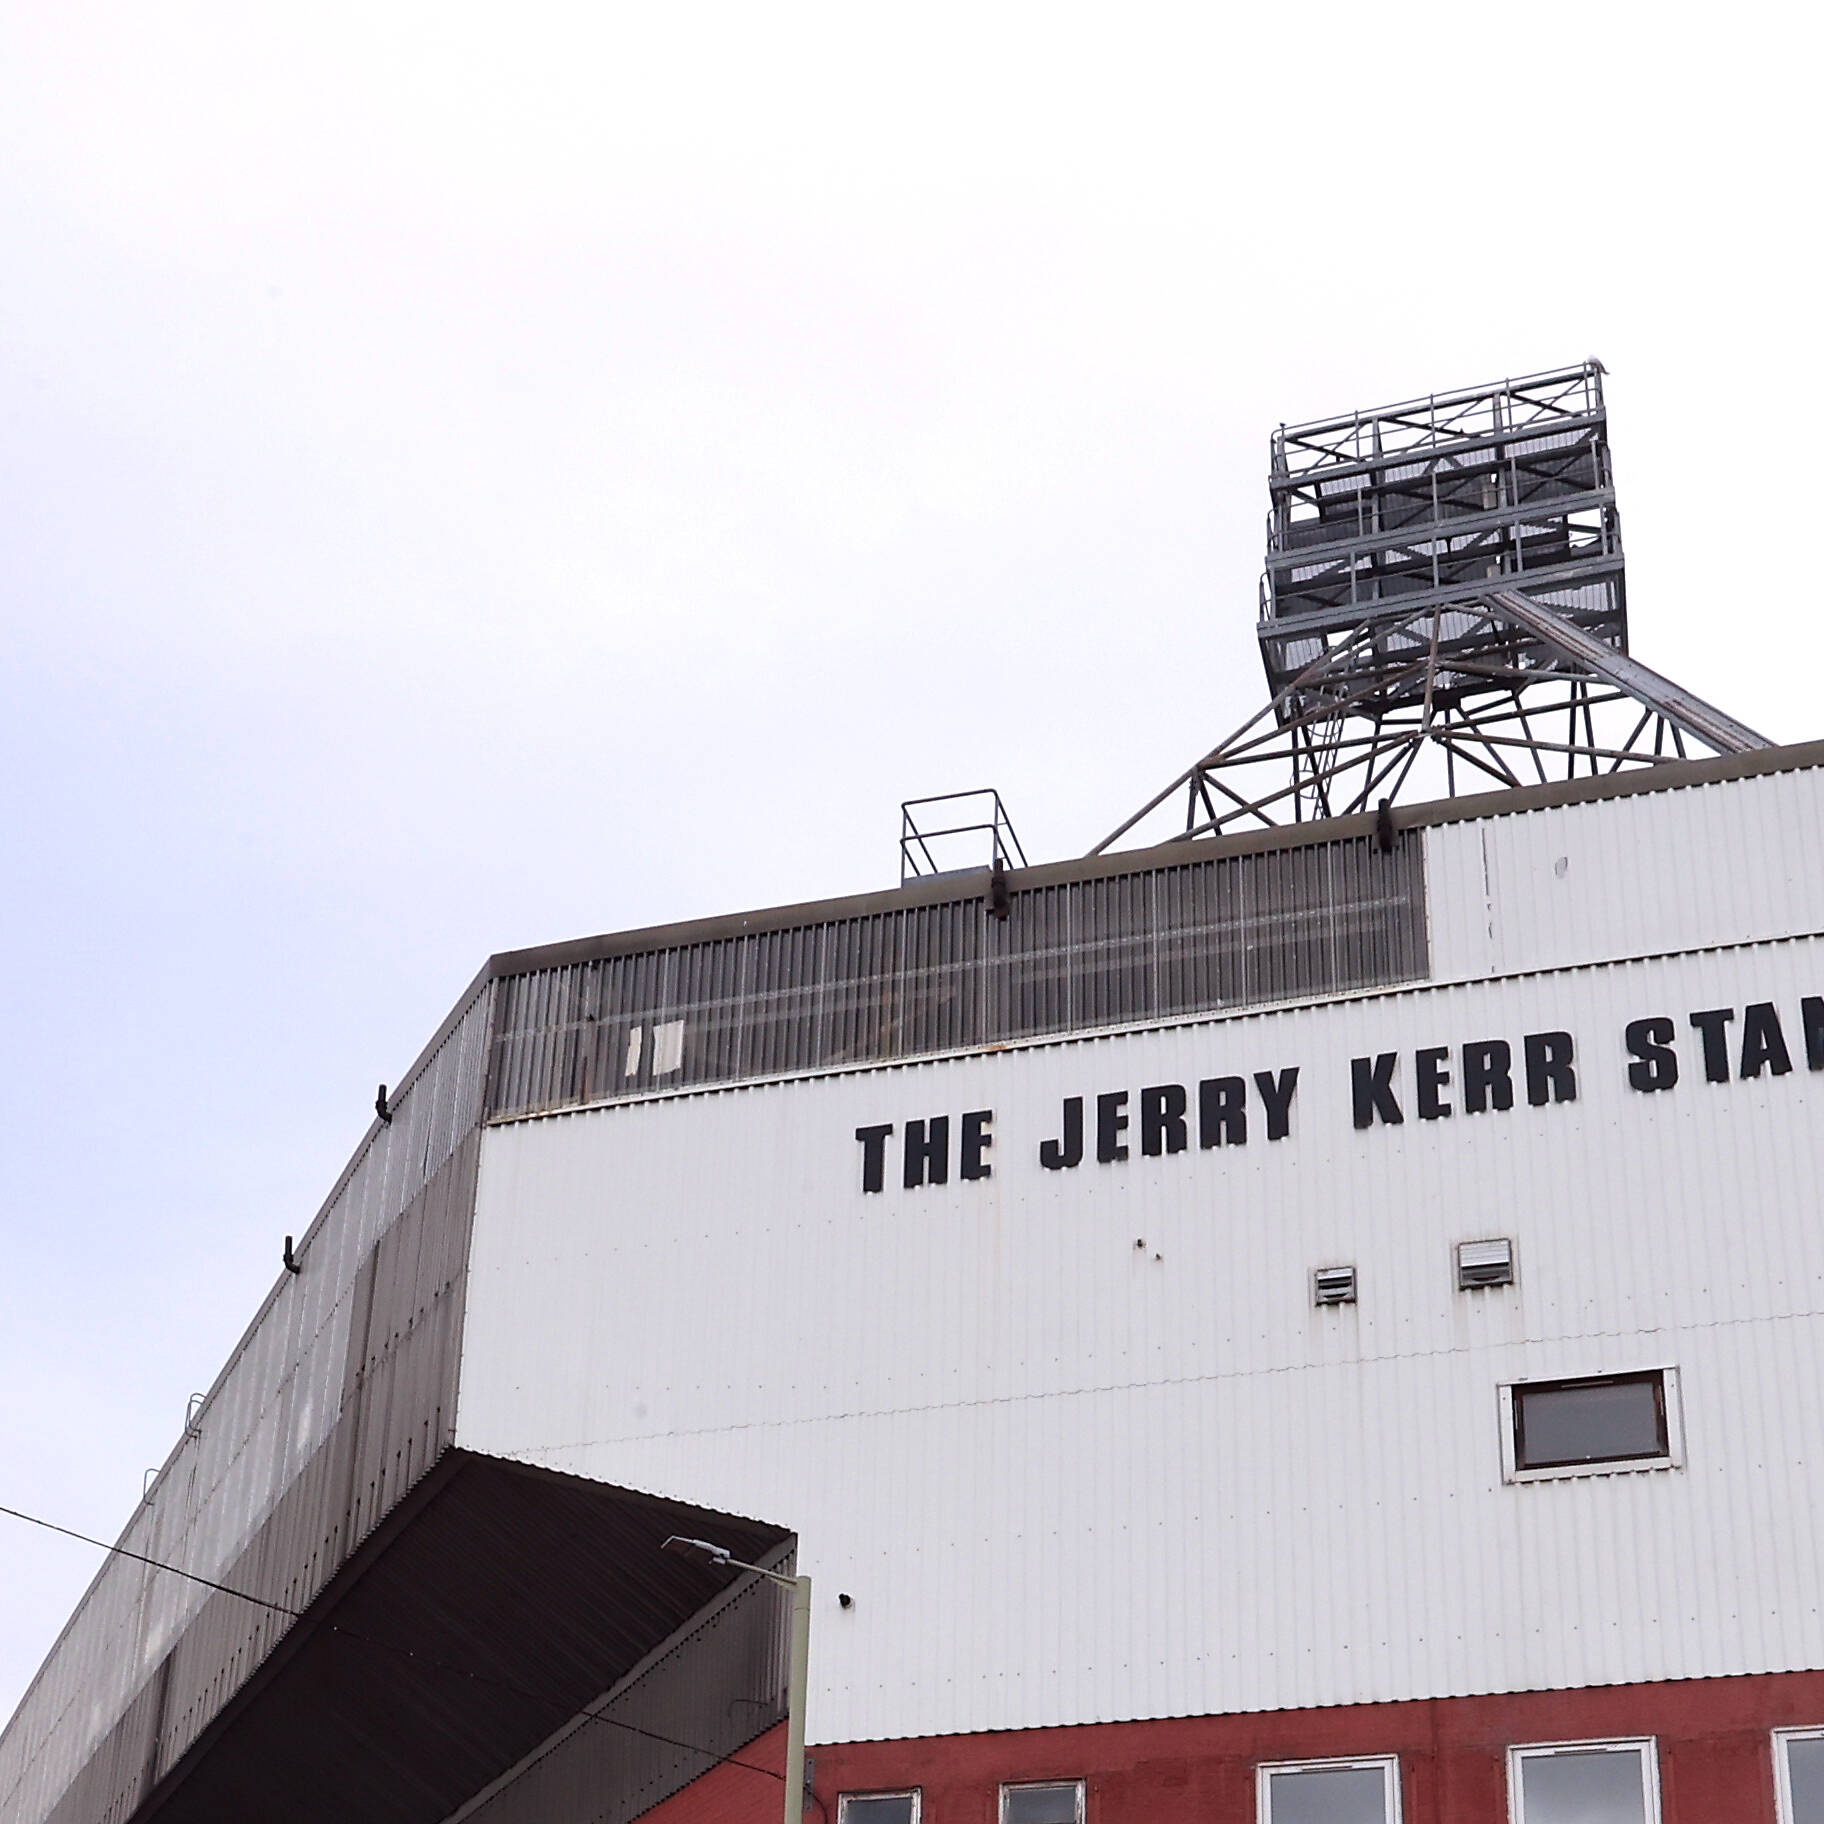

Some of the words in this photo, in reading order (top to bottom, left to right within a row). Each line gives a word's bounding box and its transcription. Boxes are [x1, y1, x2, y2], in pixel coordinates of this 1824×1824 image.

[855, 1110, 994, 1194] THE
[1039, 1066, 1301, 1171] JERRY
[1350, 1029, 1578, 1130] KERR
